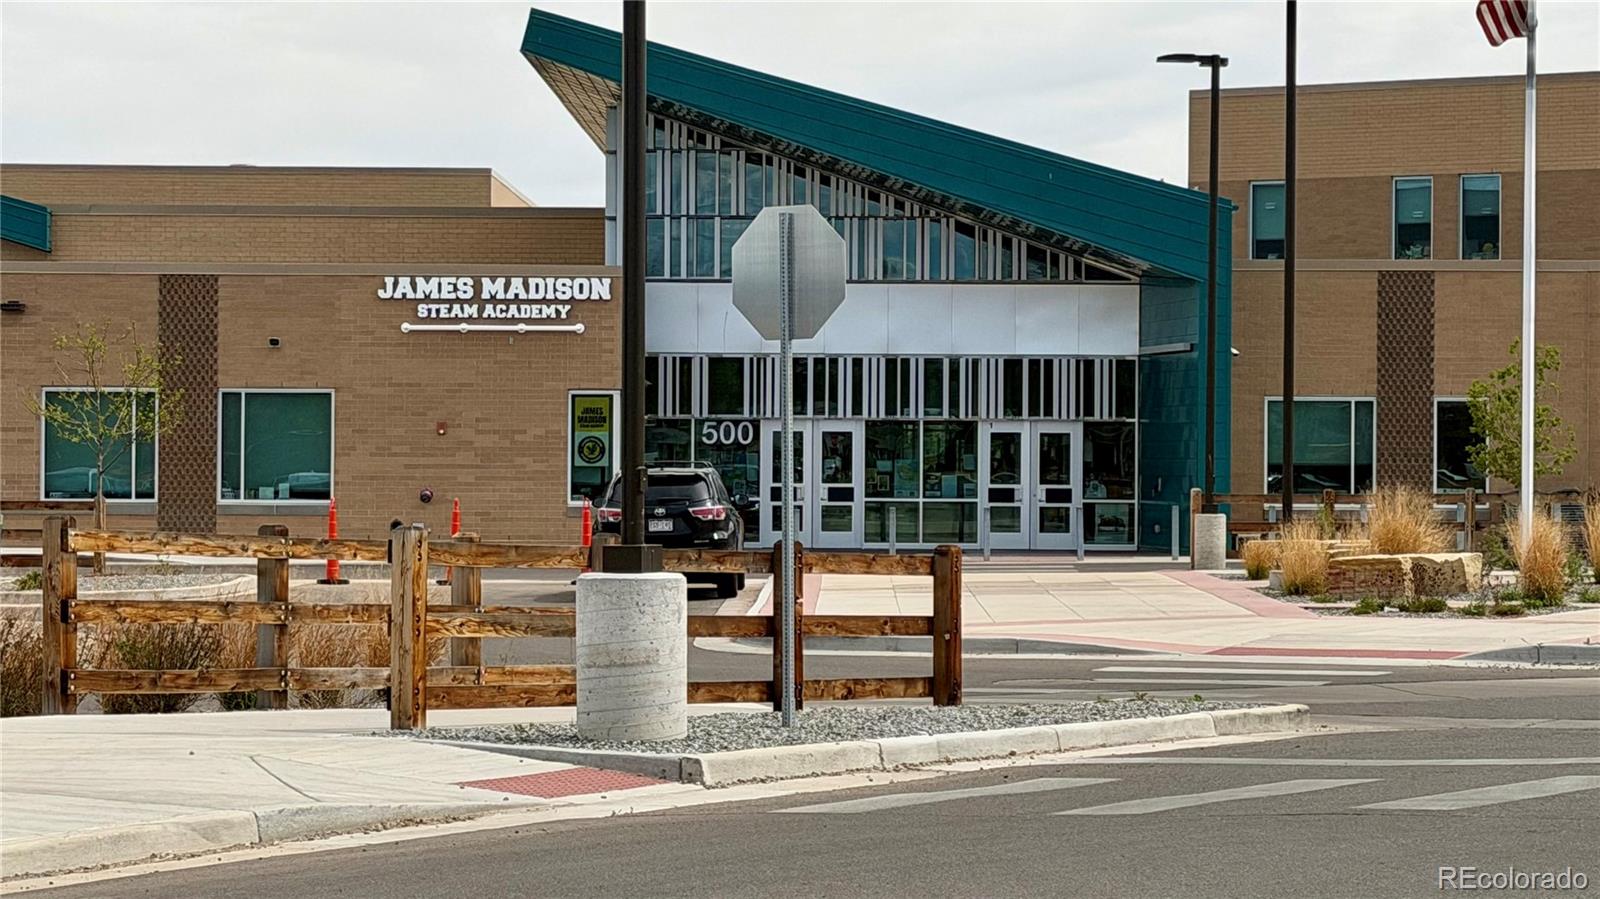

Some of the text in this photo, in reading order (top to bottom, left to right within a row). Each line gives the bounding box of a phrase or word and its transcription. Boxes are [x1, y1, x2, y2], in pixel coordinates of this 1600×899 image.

[378, 277, 611, 300] JAMES MADISON
[417, 304, 571, 319] STEAM ACADEMY
[581, 407, 604, 415] JAMES
[701, 421, 754, 445] 500
